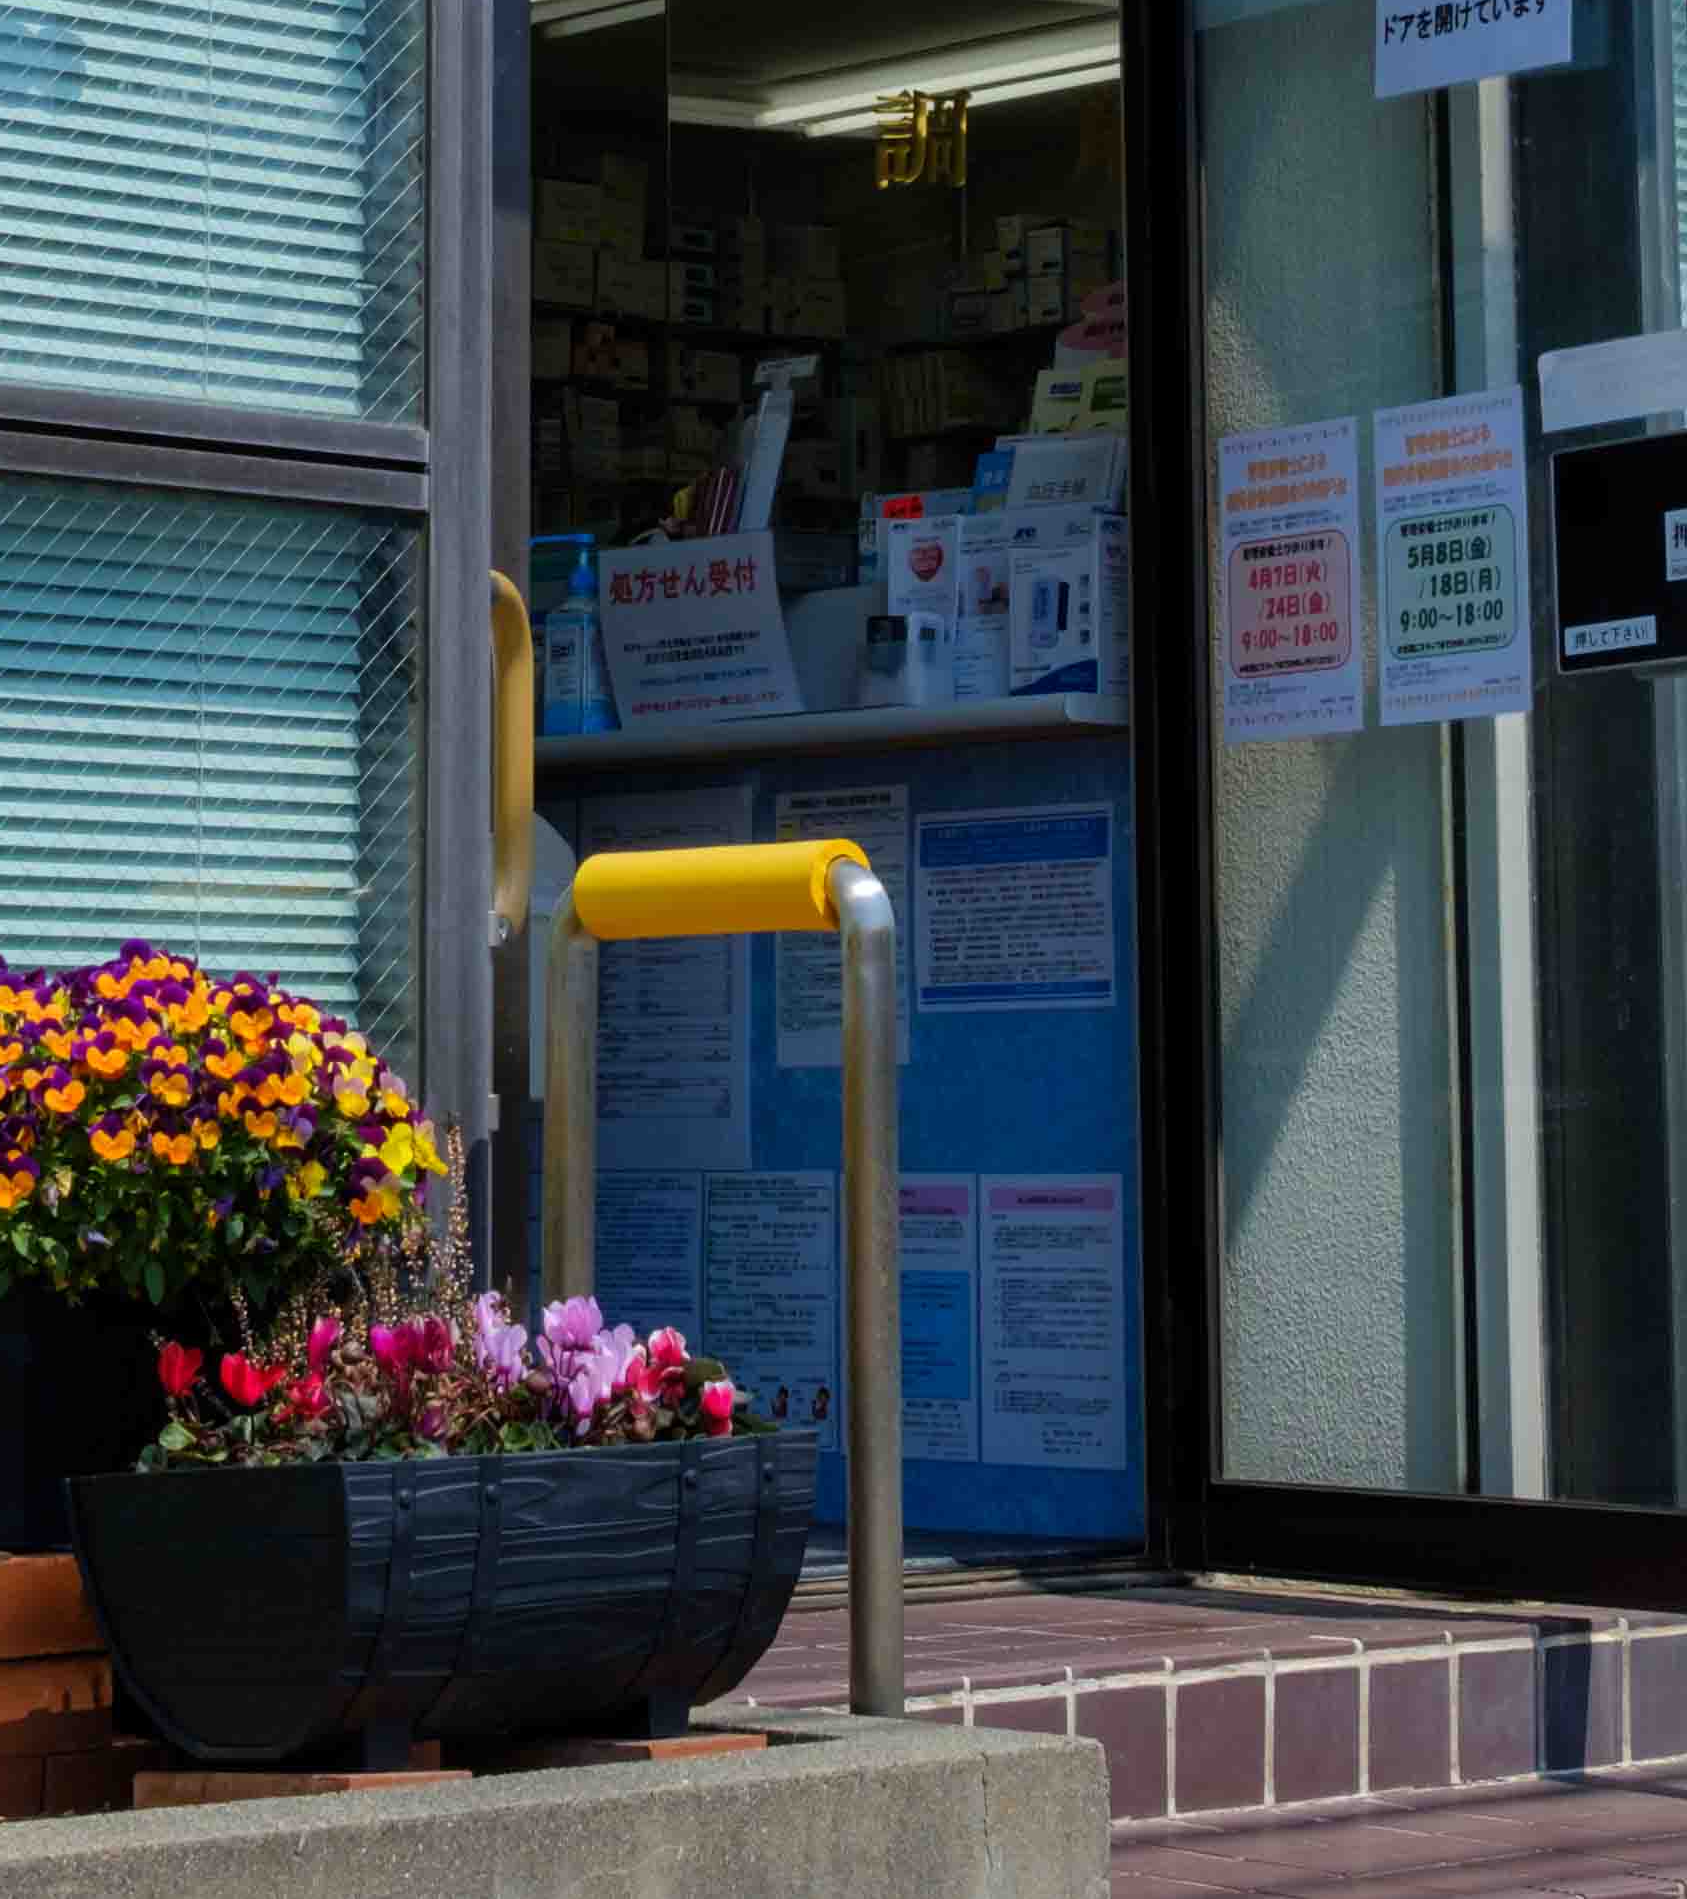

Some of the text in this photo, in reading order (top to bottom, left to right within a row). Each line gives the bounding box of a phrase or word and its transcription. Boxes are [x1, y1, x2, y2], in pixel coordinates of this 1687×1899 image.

[1407, 535, 1493, 569] 5月8日(金)
[608, 555, 759, 605] 処方せん受付
[1573, 619, 1650, 650] 押して下さい
